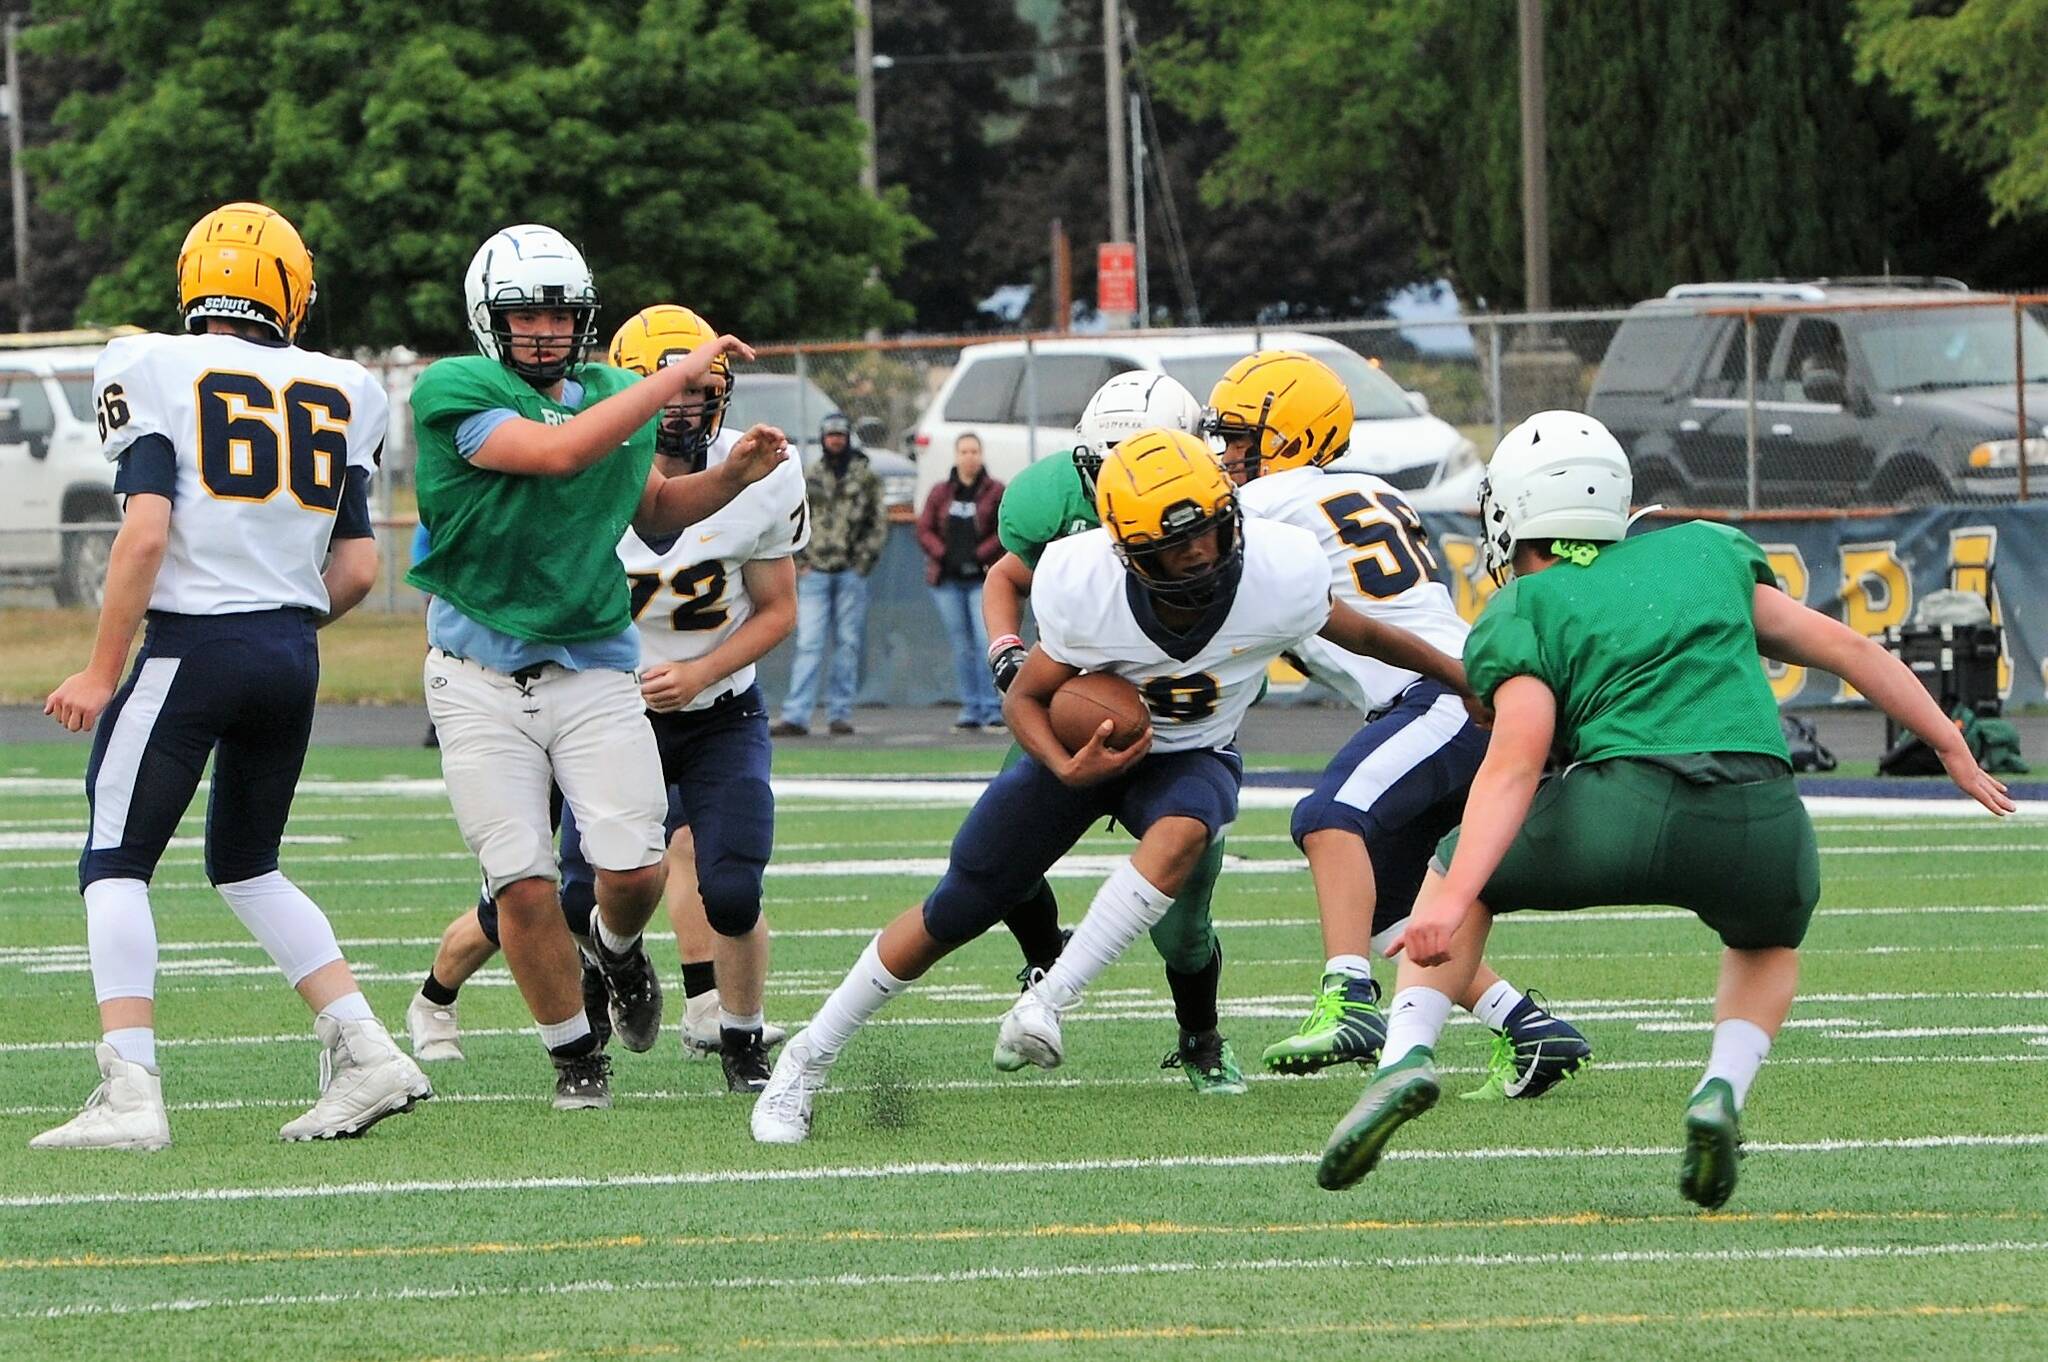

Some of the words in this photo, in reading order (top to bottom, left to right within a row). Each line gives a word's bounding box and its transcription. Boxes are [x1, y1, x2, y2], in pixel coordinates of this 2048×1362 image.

[204, 296, 251, 311] schutt
[194, 368, 353, 516] 66
[627, 559, 732, 633] 72
[1140, 672, 1222, 725] 8
